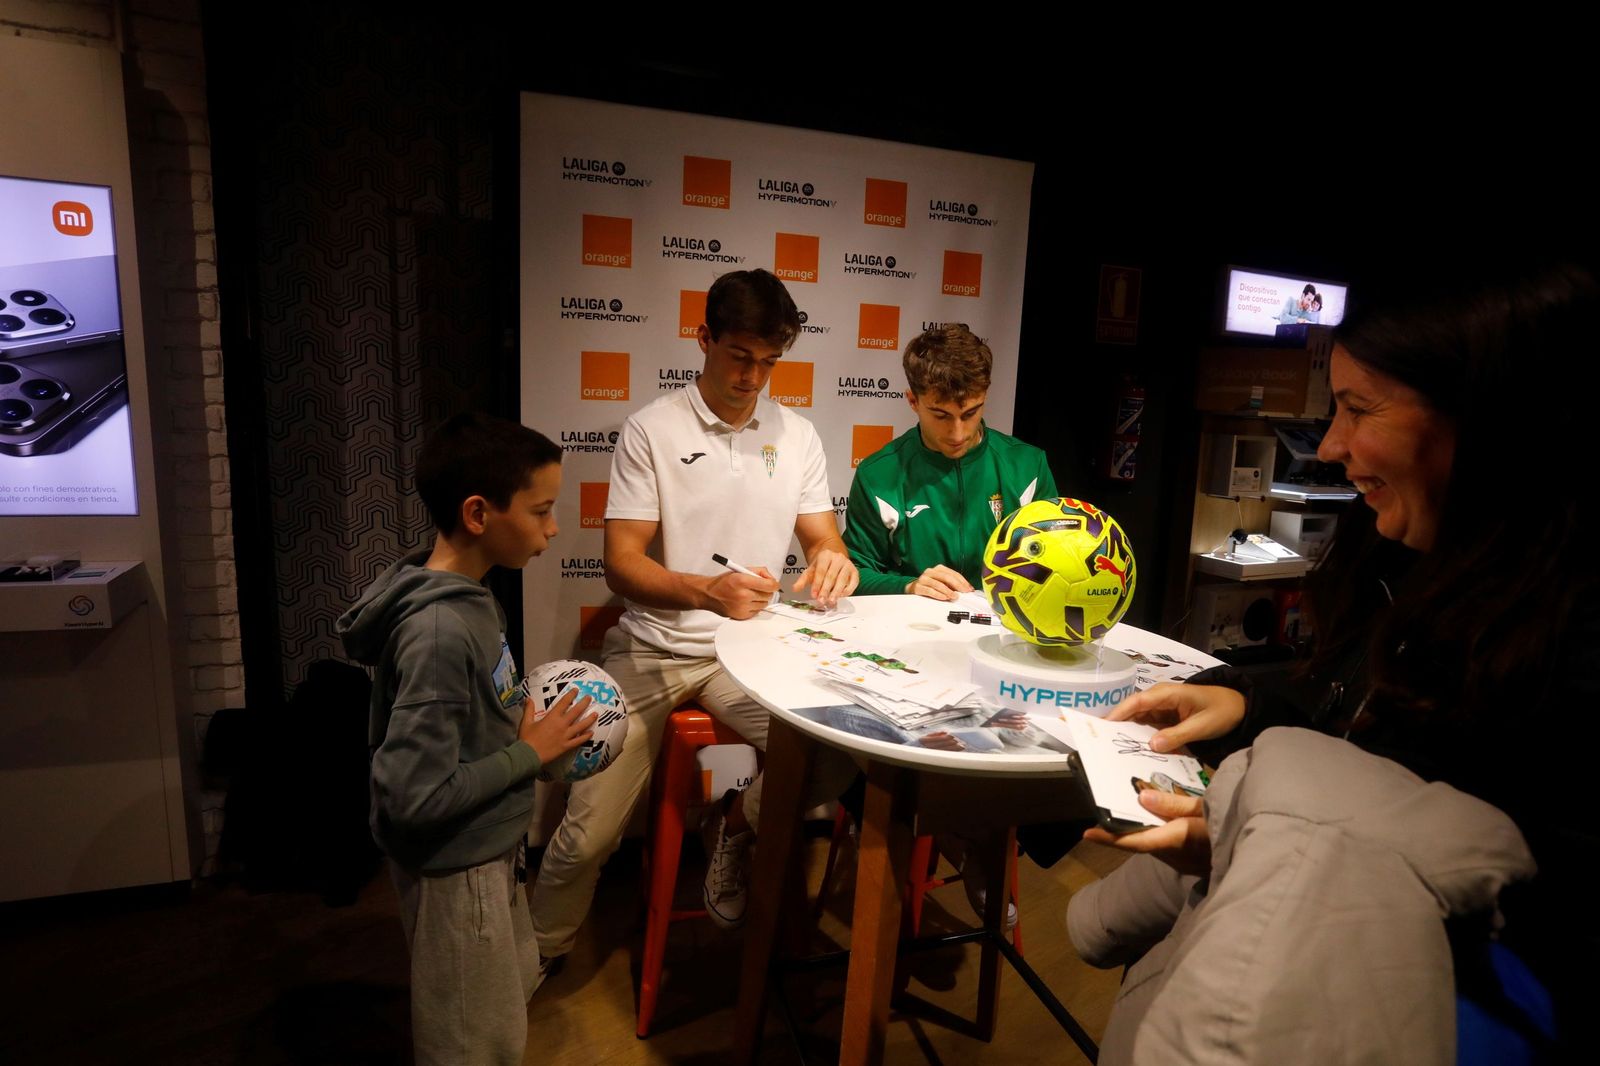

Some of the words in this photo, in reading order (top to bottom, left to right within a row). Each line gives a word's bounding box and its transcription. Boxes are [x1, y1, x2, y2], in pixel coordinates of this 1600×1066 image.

[562, 157, 609, 173] LALIGA
[759, 178, 799, 193] LALIGA
[685, 193, 726, 207] orange
[929, 200, 965, 214] LALIGA
[866, 213, 902, 225] orange
[663, 236, 705, 250] LALIGA
[585, 252, 627, 265] orange
[844, 253, 882, 267] LALIGA
[777, 267, 813, 280] orange
[943, 283, 976, 294] orange
[1240, 283, 1277, 296] Dispositivos
[561, 297, 606, 311] LALIGA
[1238, 295, 1251, 303] que
[1251, 296, 1280, 305] conectan
[1237, 303, 1262, 313] contigo
[681, 326, 699, 335] ora
[860, 337, 894, 349] orange
[839, 377, 875, 389] LALIGA
[583, 388, 624, 399] orange
[771, 394, 808, 405] orange
[561, 431, 605, 443] LALIGA
[561, 444, 615, 453] HYPERMO
[33, 485, 54, 493] fines
[23, 495, 76, 503] condiciones
[583, 517, 604, 525] ora
[562, 558, 604, 569] LALIGA
[1087, 588, 1112, 596] LALIGA
